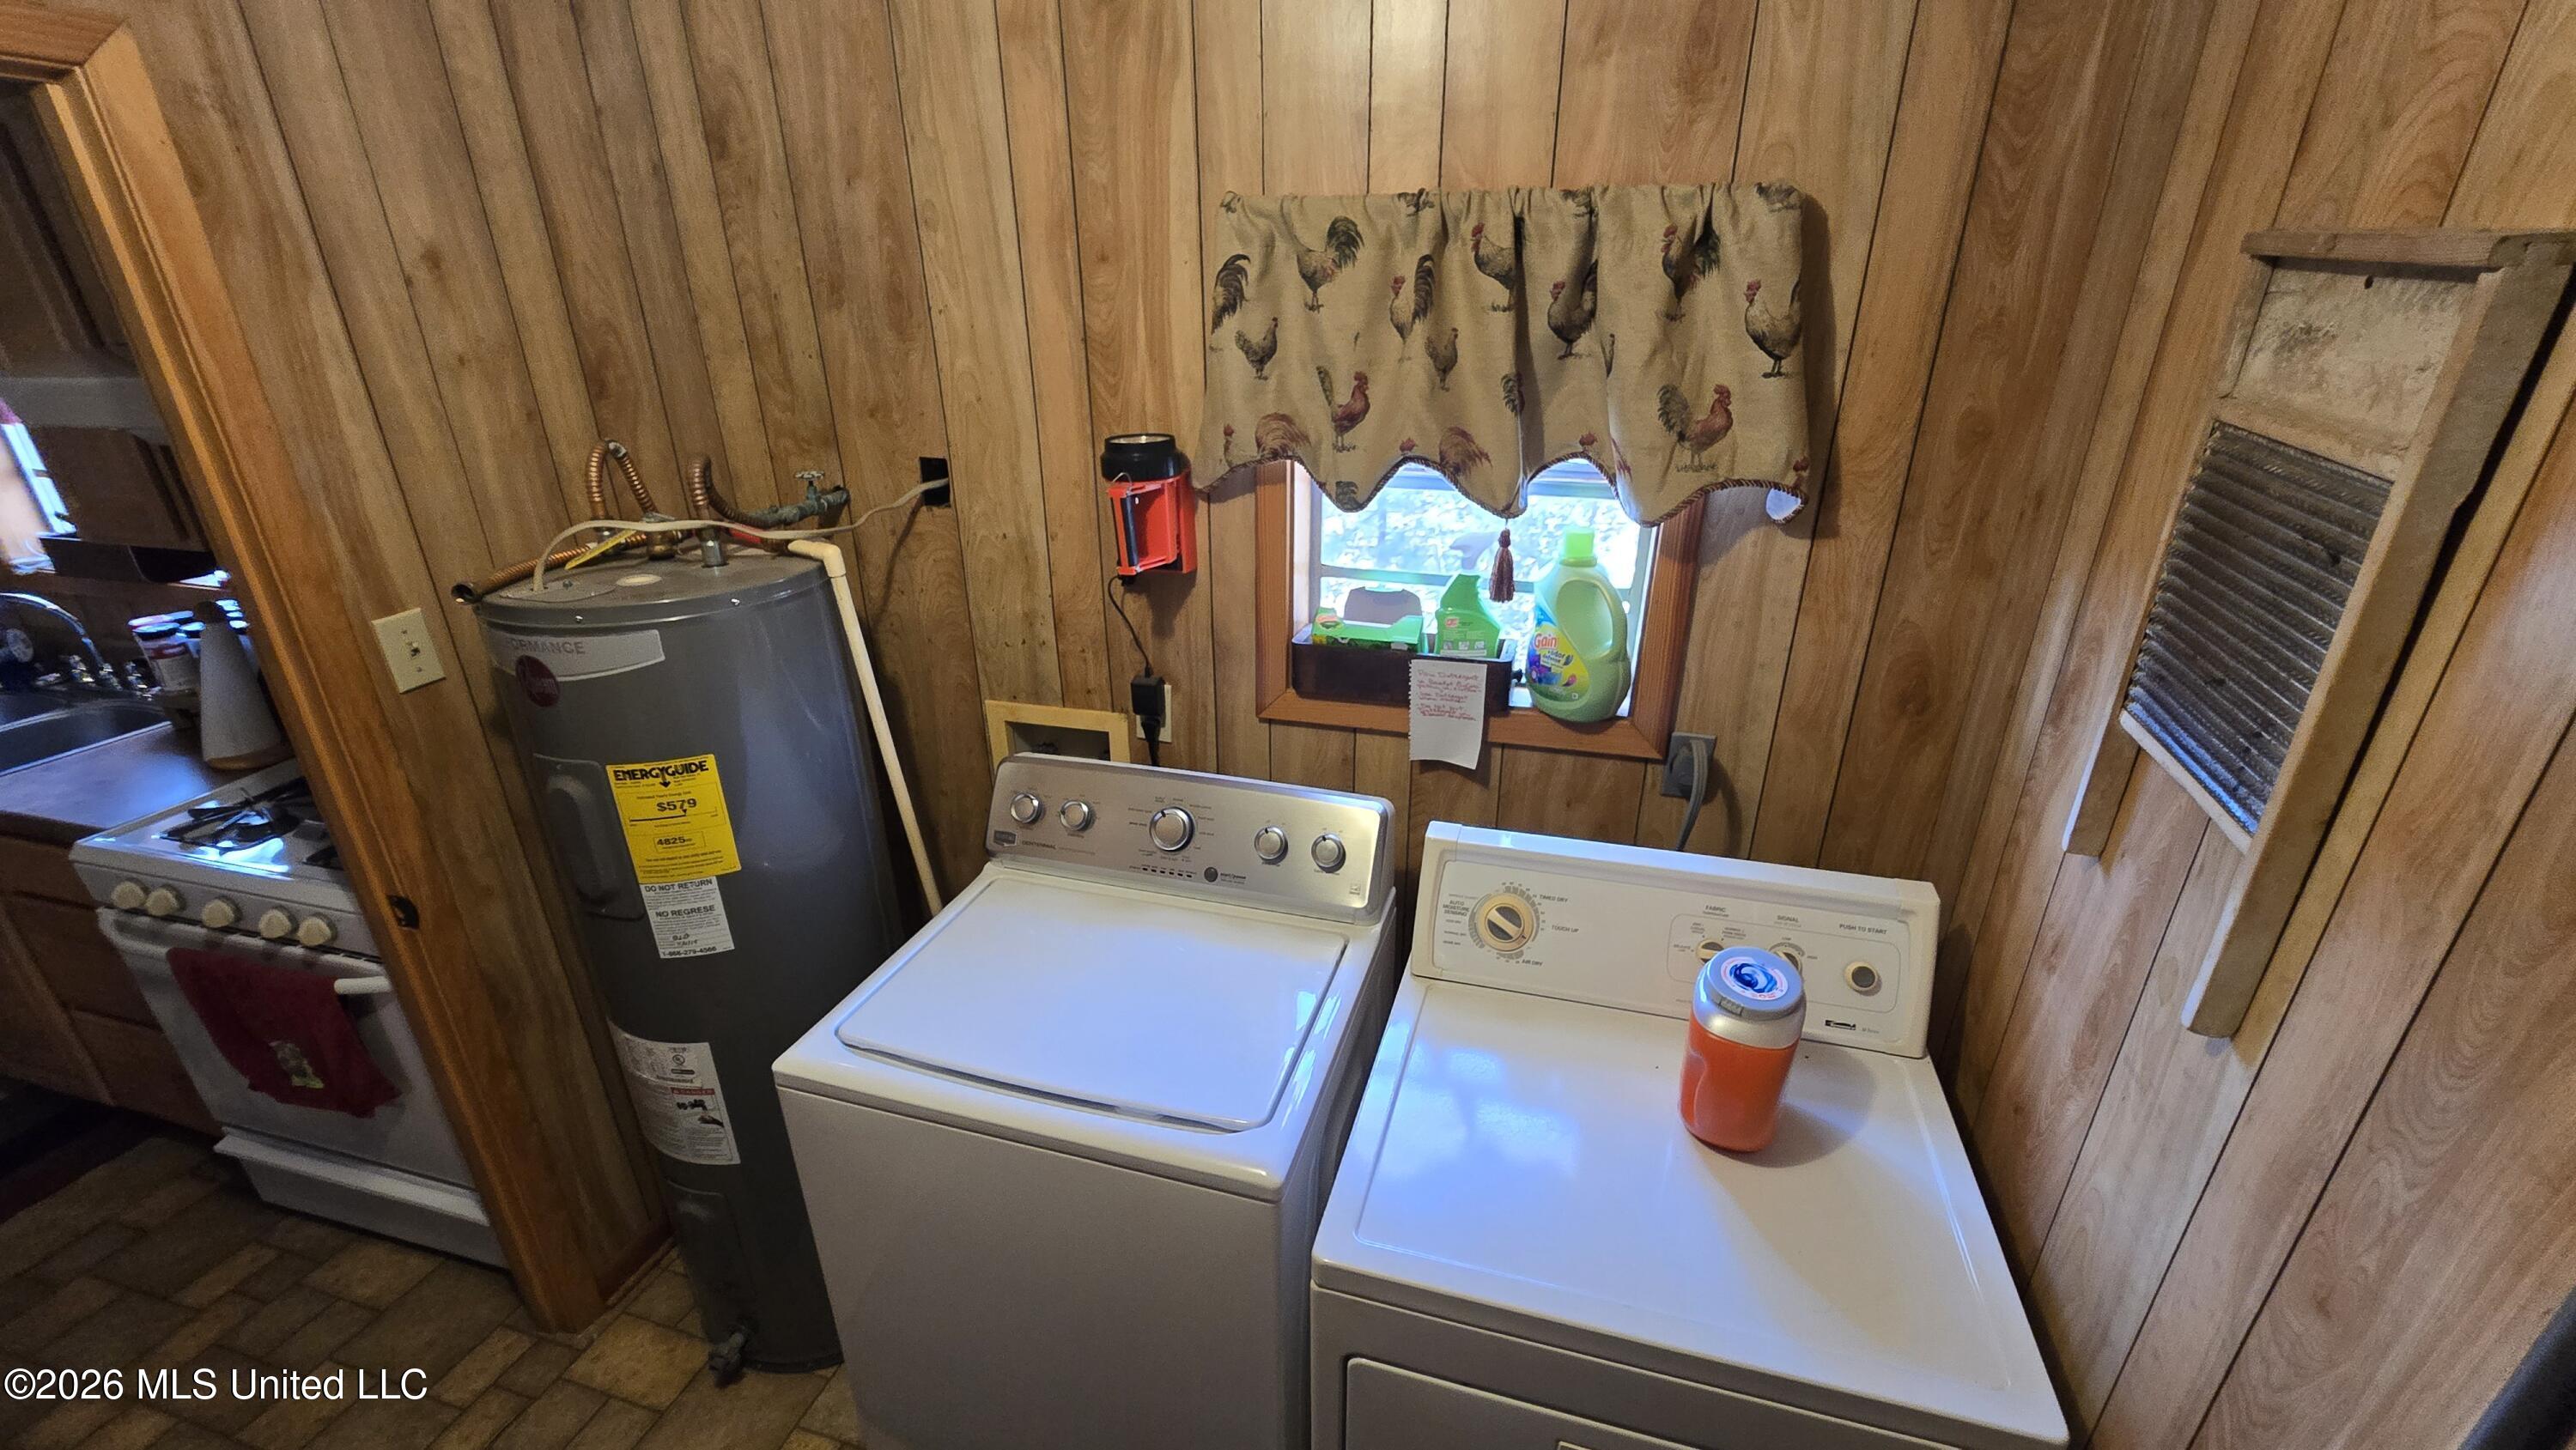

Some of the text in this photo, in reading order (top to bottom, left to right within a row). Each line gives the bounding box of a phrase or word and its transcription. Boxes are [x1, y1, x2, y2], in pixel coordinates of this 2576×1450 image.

[1534, 633, 1557, 649] Gain
[613, 760, 709, 781] ENERGYGUIDE
[656, 798, 697, 812] $579
[656, 836, 686, 846] 4825
[677, 878, 713, 890] RETURN
[671, 904, 716, 916] REGRESE
[1777, 914, 1800, 923] SIGNAL
[1838, 923, 1857, 931] PUSH
[1867, 926, 1887, 935] START
